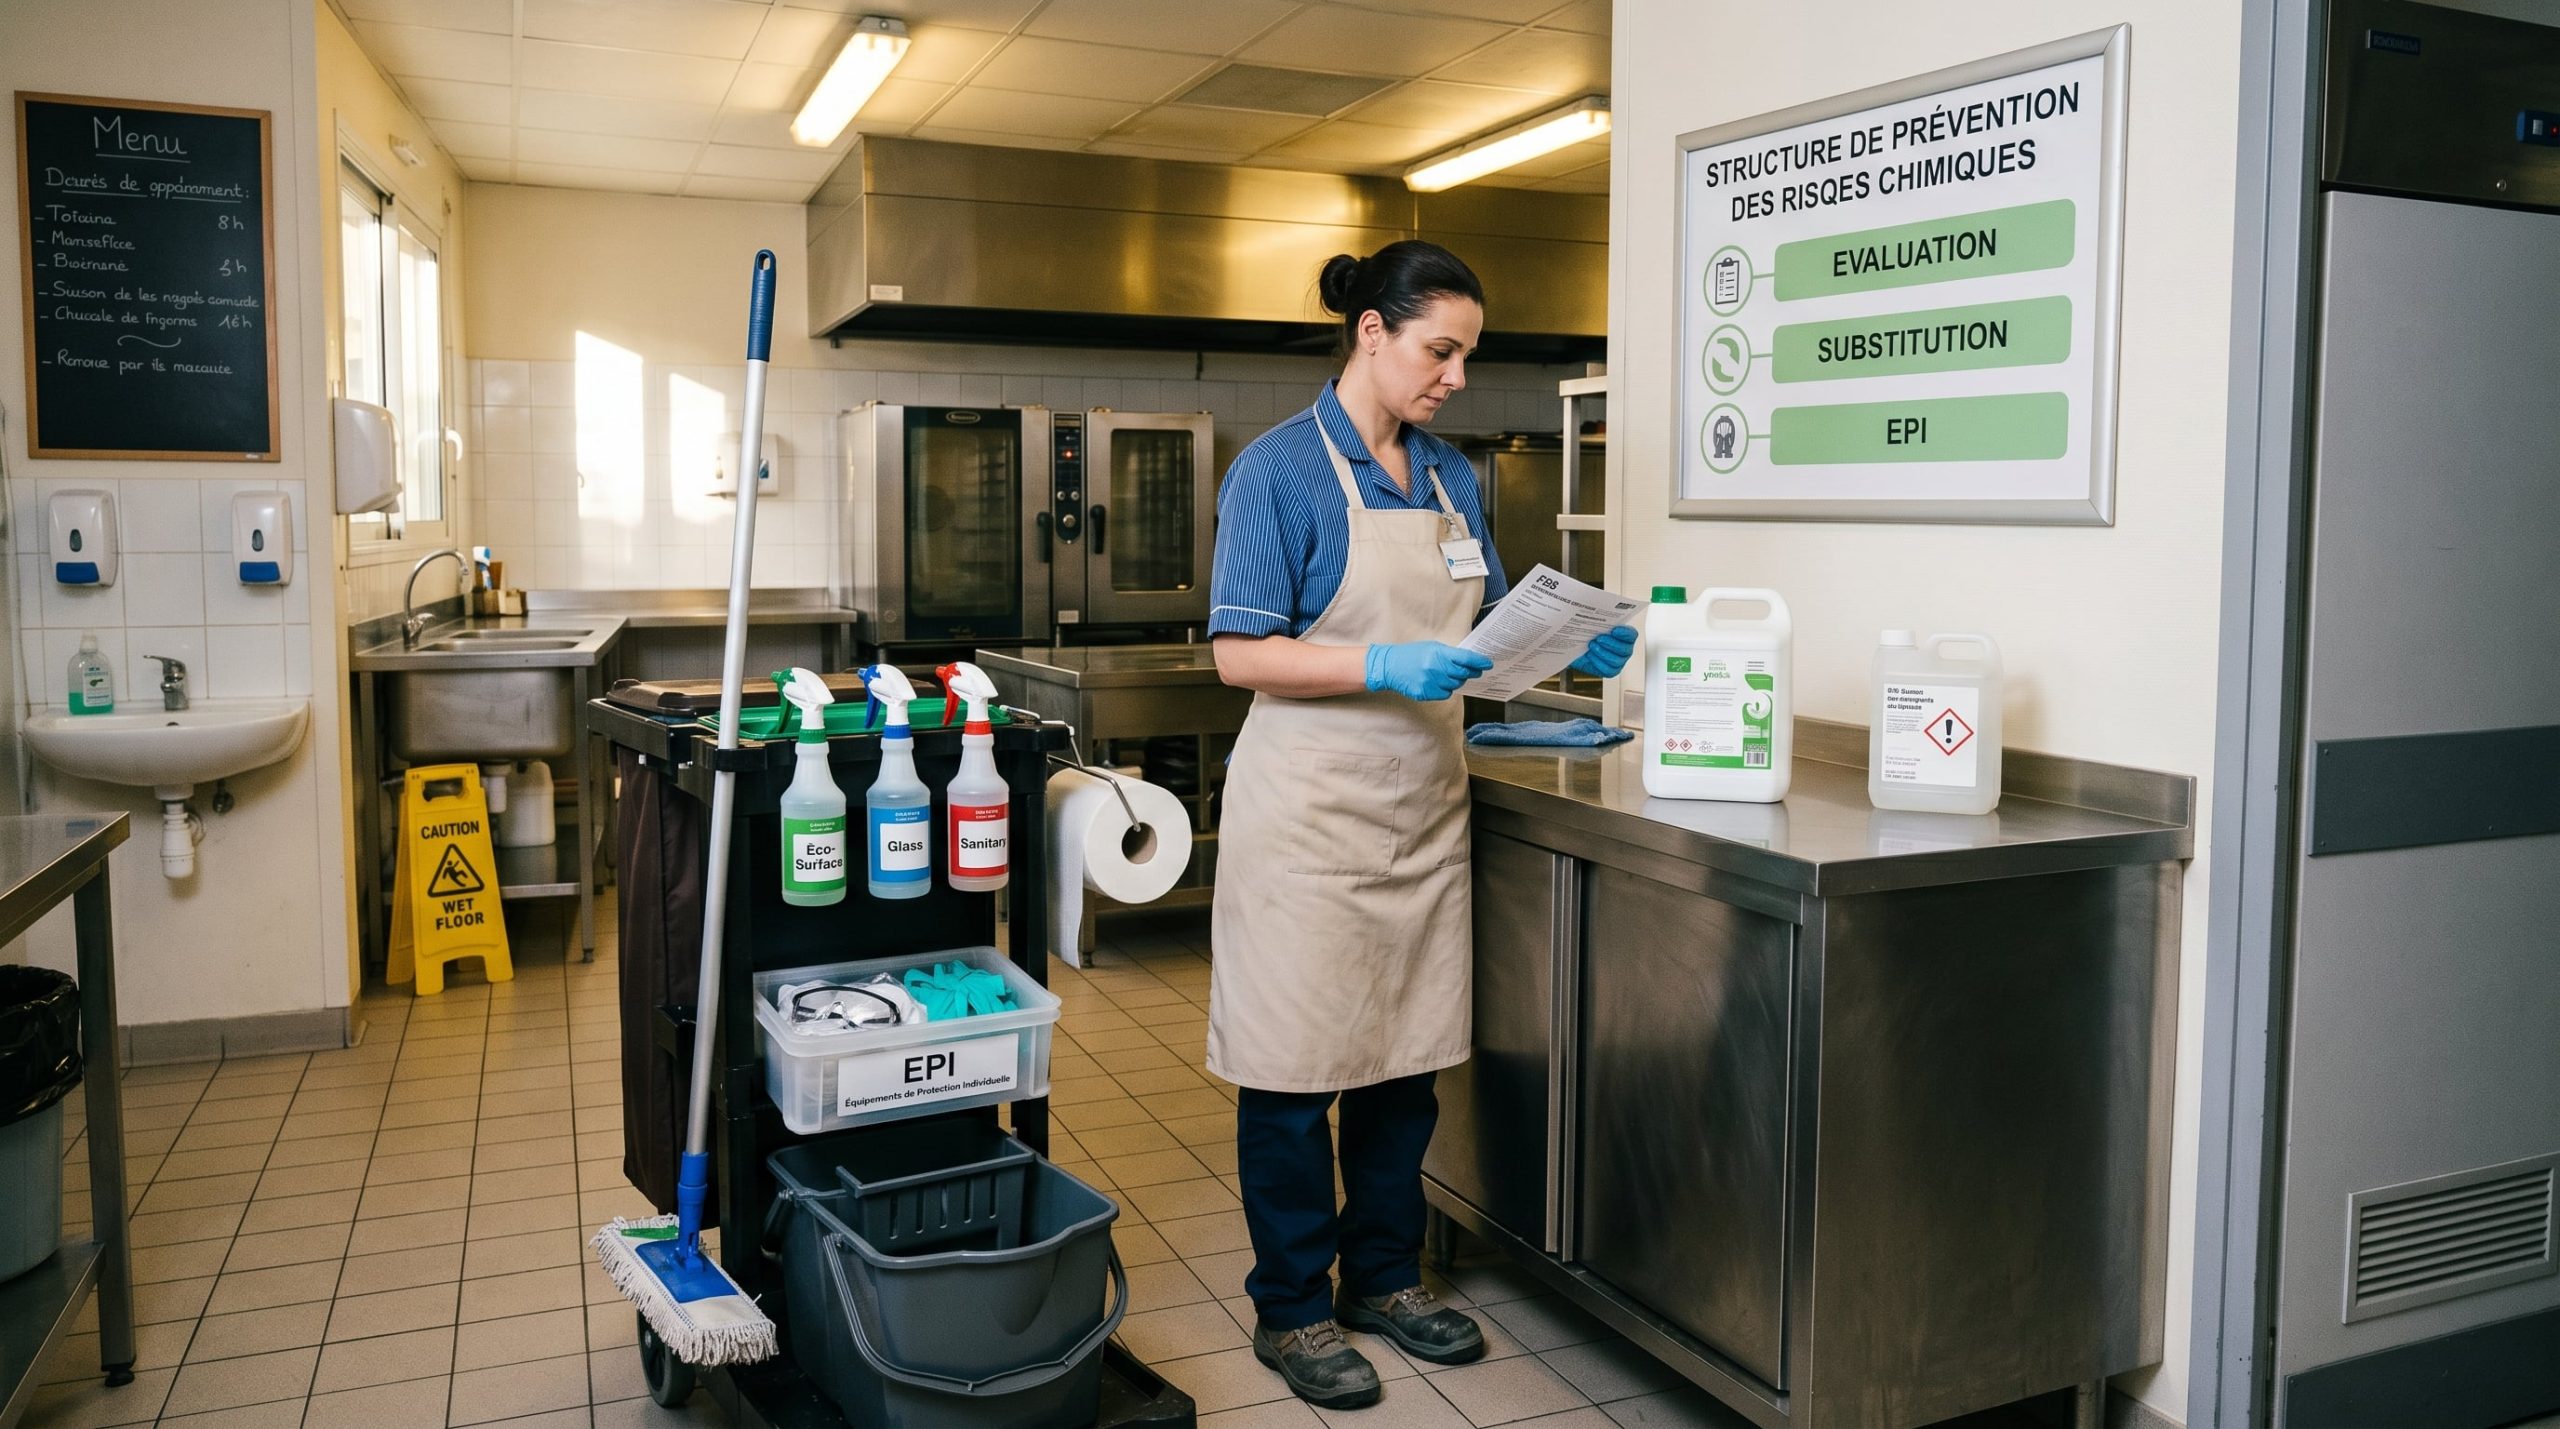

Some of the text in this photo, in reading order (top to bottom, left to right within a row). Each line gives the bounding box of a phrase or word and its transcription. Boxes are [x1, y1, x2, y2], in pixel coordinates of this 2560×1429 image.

[93, 115, 187, 154] Menu
[1706, 82, 2080, 188] STRUCTURE DE PRÉVENTION
[120, 174, 140, 191] de
[1732, 139, 2036, 222] DES RISQES CHIMIQUES
[1833, 228, 1998, 277] EVALUATION
[115, 287, 132, 300] de
[139, 287, 157, 301] les
[121, 312, 139, 323] de
[1818, 320, 2008, 363] SUBSTITUTION
[119, 361, 144, 375] par
[1887, 417, 1927, 445] EPI
[421, 821, 480, 840] CAUTION
[887, 840, 923, 852] Glass
[960, 838, 1007, 851] Sanitary
[795, 858, 843, 871] Surface
[442, 898, 475, 914] WET
[436, 912, 485, 931] FLOOR
[904, 1052, 954, 1084] EPI
[845, 1075, 1011, 1107] Équipements de Protection Individuelle
